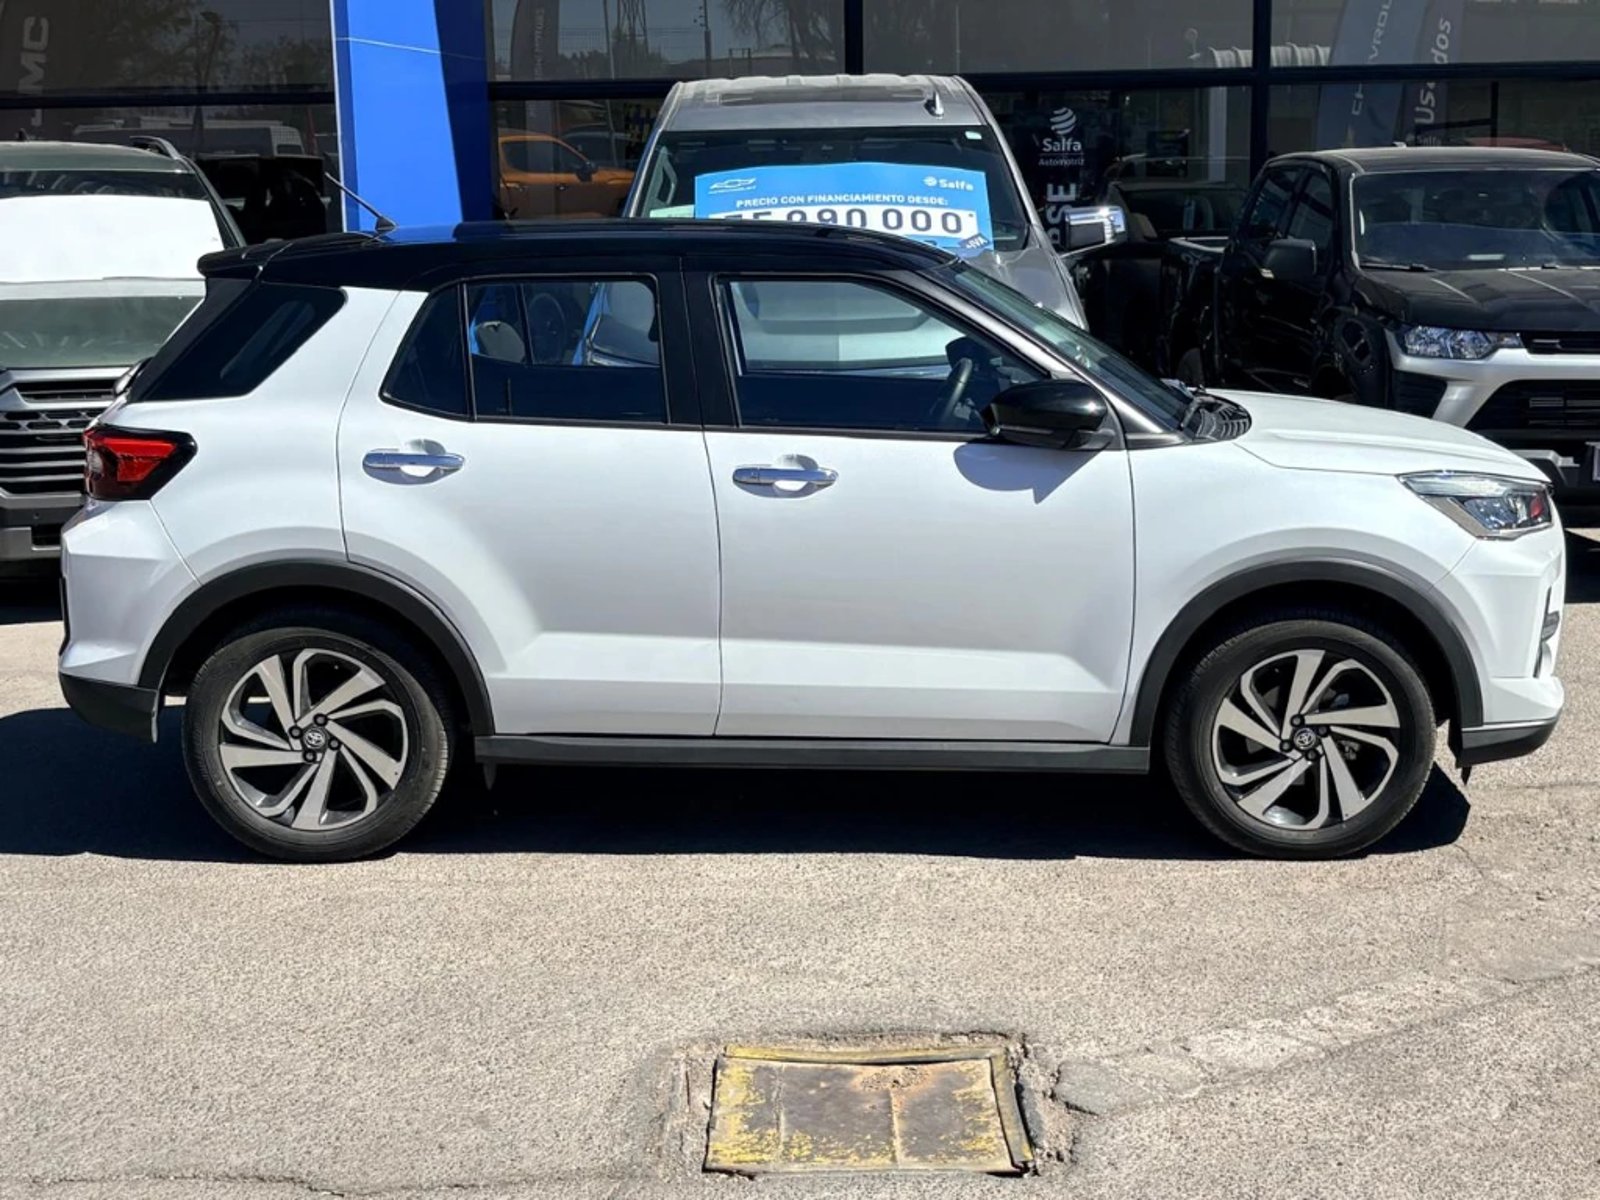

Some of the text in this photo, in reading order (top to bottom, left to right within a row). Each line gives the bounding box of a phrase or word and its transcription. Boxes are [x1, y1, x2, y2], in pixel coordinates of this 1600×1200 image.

[1414, 18, 1451, 124] Usdos
[1042, 137, 1082, 152] Salfa
[939, 178, 974, 191] Salfa
[736, 193, 949, 208] PRECIO CON FINANCIAMIENTO DESDE:
